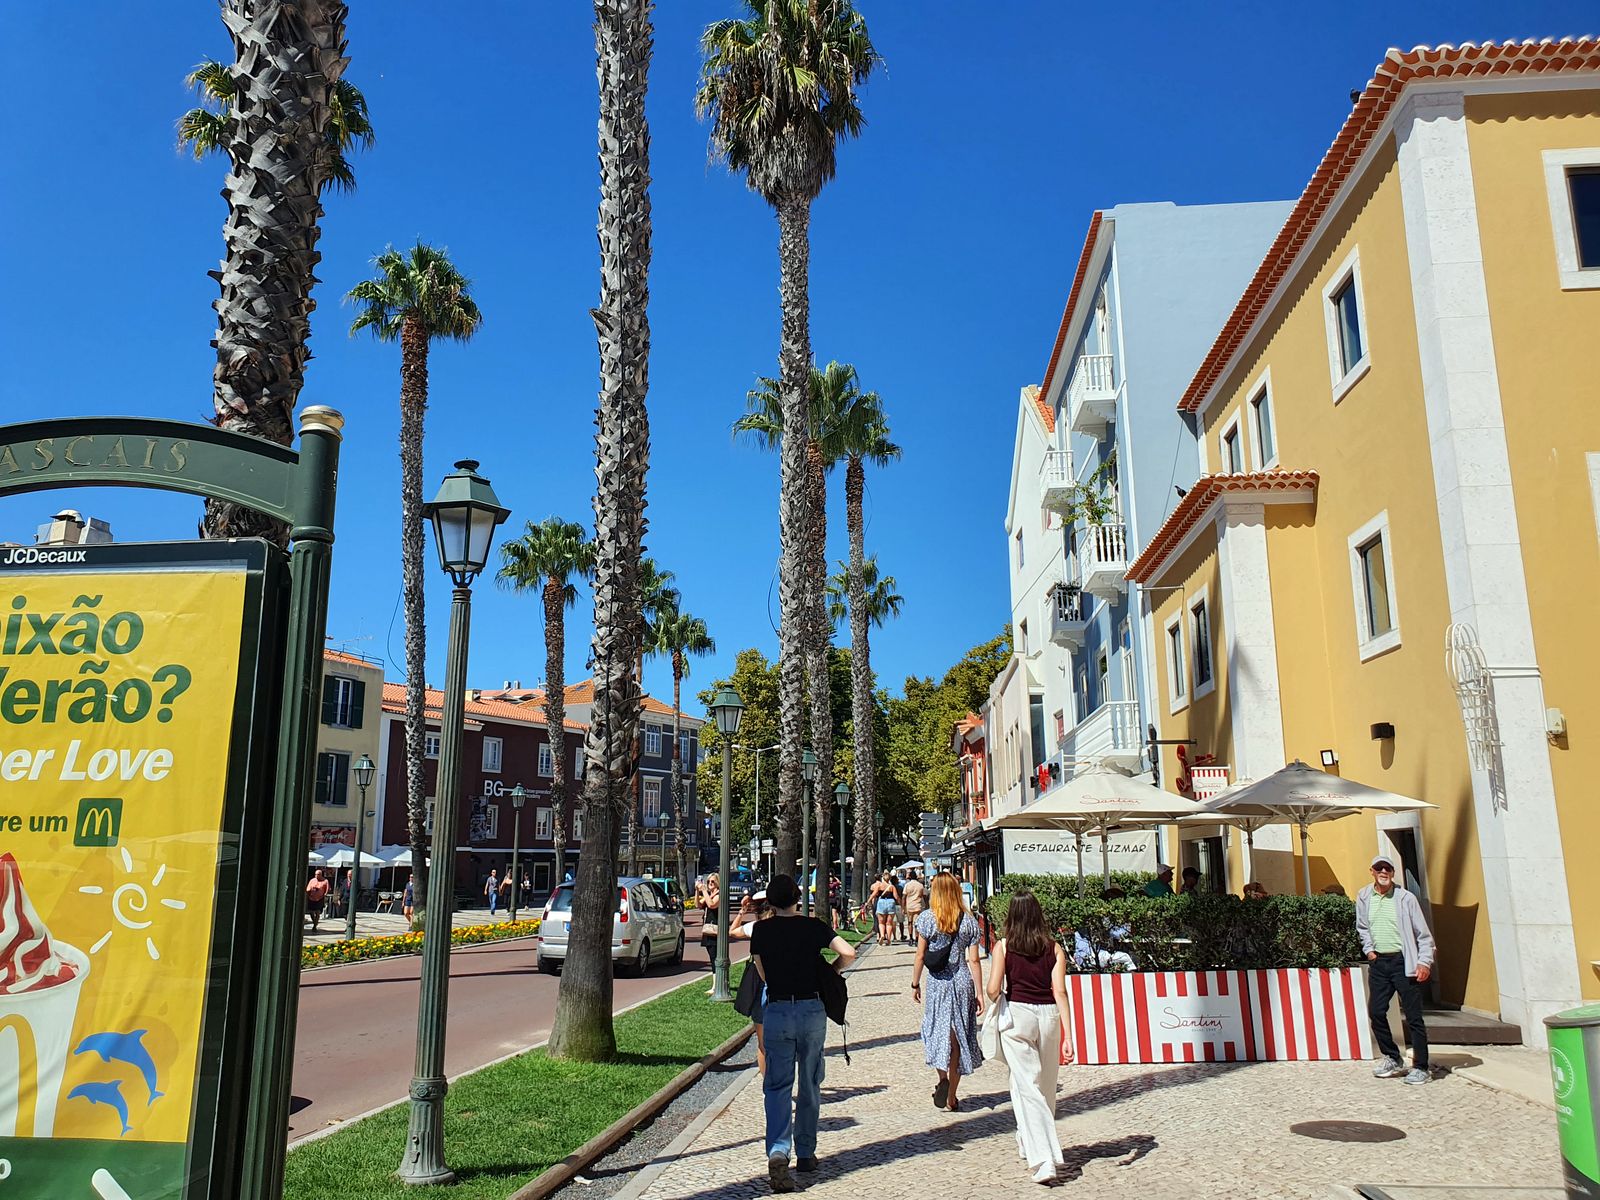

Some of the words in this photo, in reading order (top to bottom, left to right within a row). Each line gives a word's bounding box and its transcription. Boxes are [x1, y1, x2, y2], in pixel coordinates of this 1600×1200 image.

[4, 548, 87, 564] JCDecaux
[0, 594, 144, 656] ixão
[0, 748, 56, 782] er
[59, 739, 173, 782] Love
[29, 815, 68, 832] um
[1013, 843, 1093, 853] RESTAURANTE
[1099, 843, 1147, 853] LUZMAR
[1160, 1007, 1230, 1030] Santini
